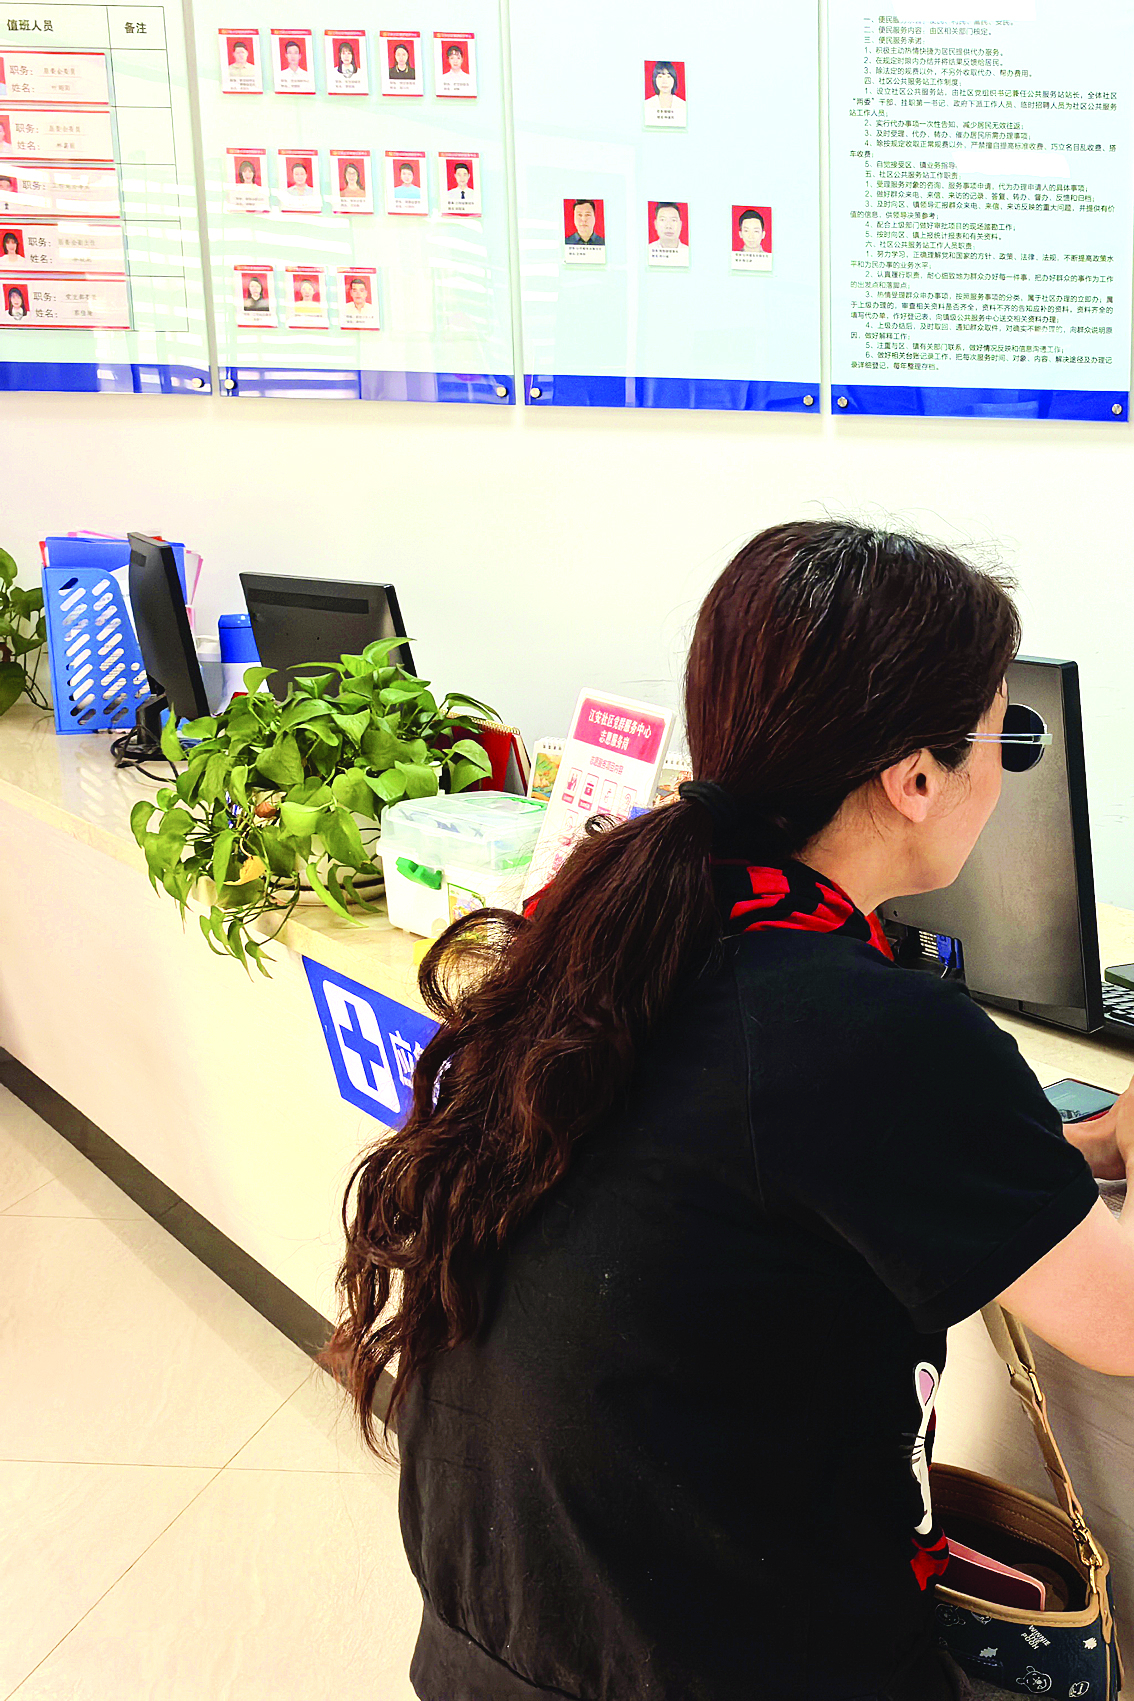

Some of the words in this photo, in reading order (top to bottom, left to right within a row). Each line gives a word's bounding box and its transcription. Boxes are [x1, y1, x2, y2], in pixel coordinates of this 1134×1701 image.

[7, 19, 54, 32] 值班人员
[124, 22, 147, 34] 备注
